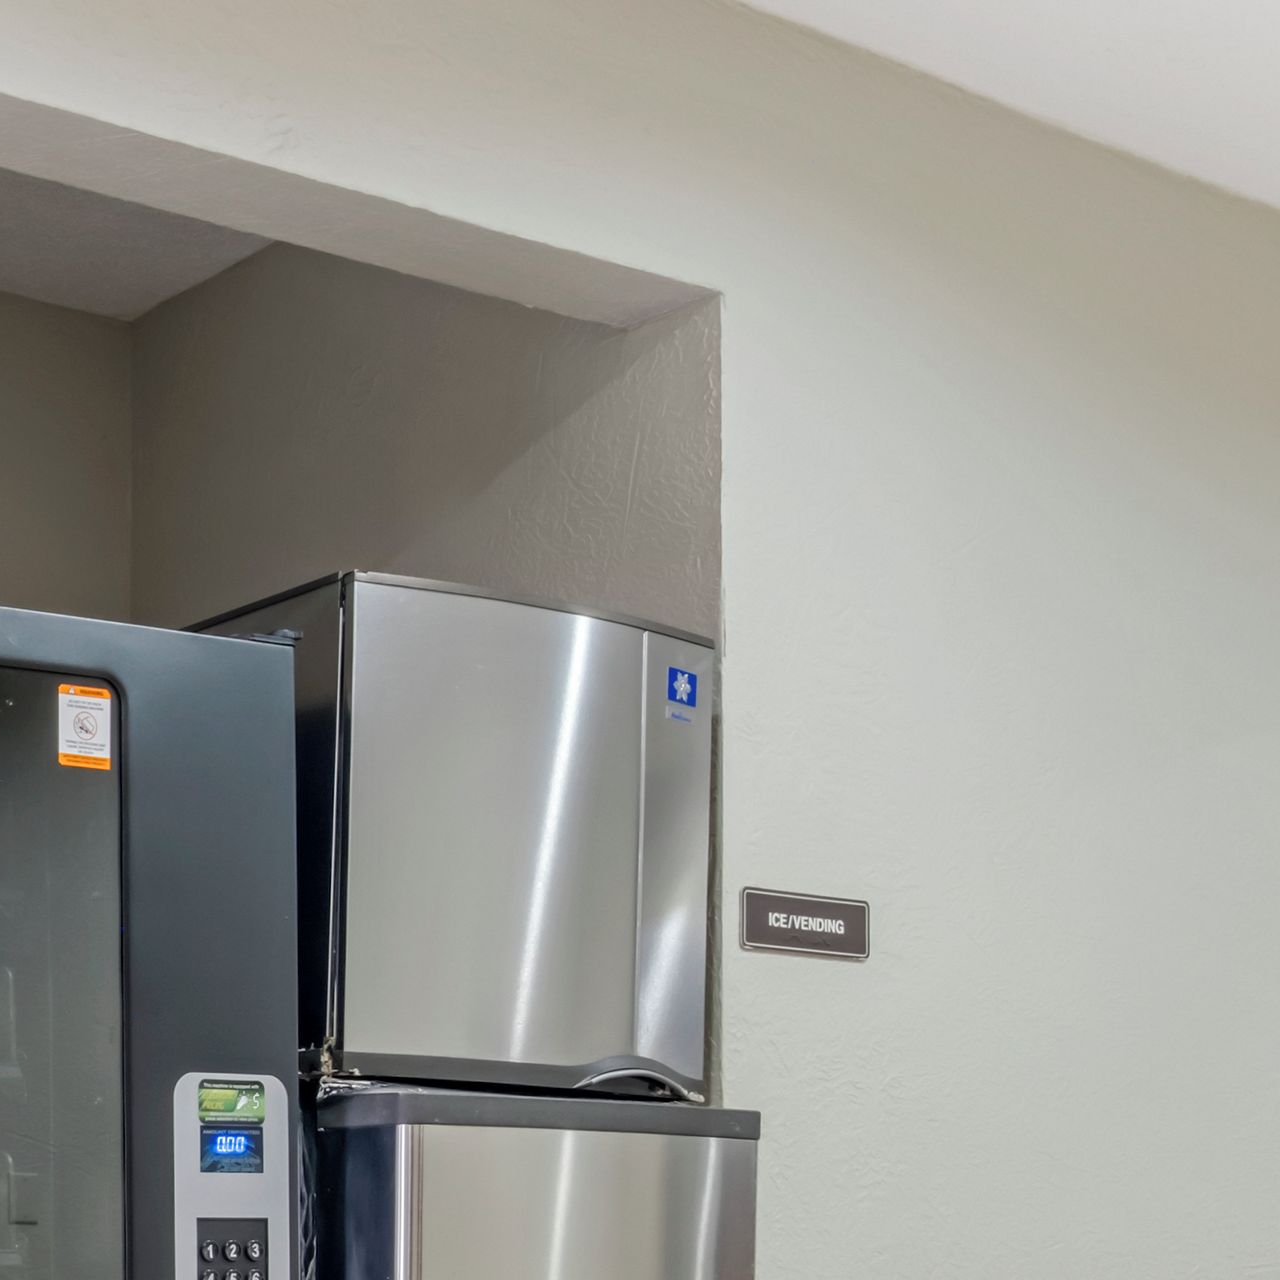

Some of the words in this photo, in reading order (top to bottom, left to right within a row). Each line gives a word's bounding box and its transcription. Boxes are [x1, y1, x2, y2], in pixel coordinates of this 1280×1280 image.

[768, 912, 845, 934] ICE/VENDING
[207, 1244, 213, 1259] 1
[229, 1244, 237, 1258] 2
[252, 1243, 260, 1257] 3
